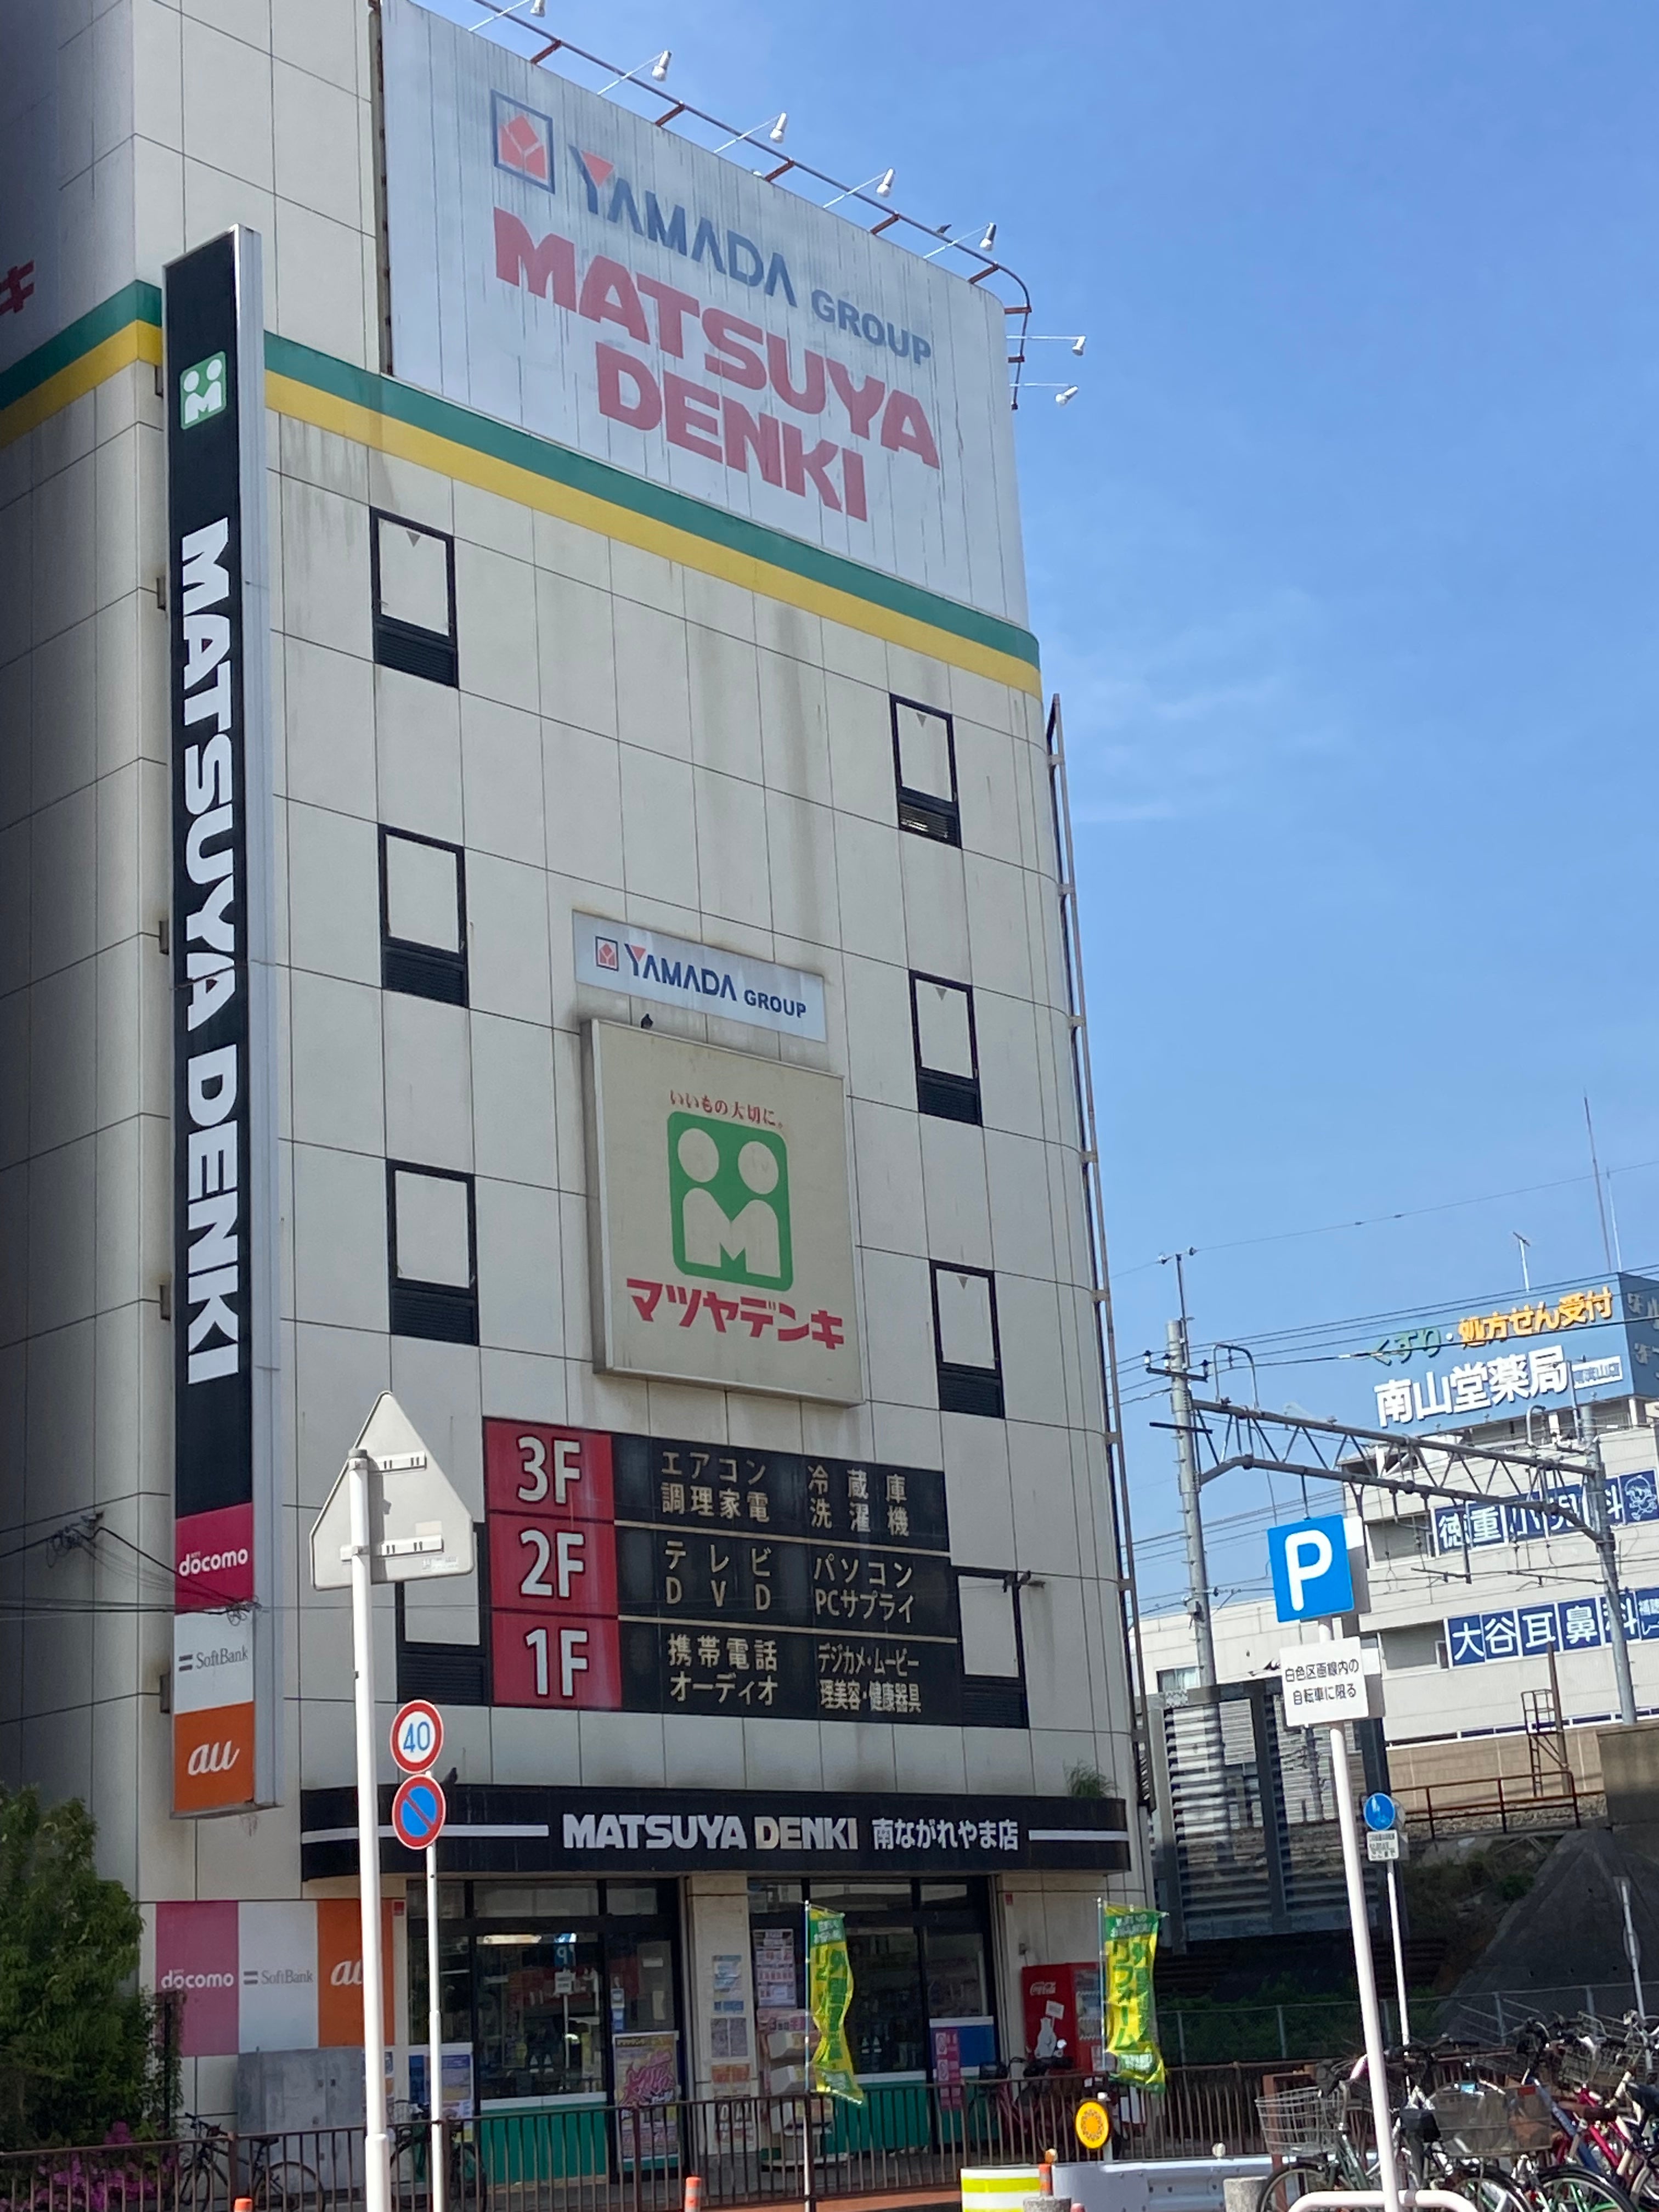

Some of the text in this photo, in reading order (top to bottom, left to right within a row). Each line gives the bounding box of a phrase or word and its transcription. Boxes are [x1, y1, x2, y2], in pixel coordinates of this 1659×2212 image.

[568, 144, 932, 364] YAMADA GROUP
[494, 207, 940, 470] MATSUYA
[595, 341, 867, 522] DENKI
[182, 517, 239, 1384] MATSUYA DENKI
[624, 943, 806, 1019] YAMADA GROUP
[627, 1278, 845, 1350] マツヤデンキ
[1374, 1345, 1568, 1428] 南山堂薬局
[517, 1435, 582, 1505] 3F
[661, 1451, 766, 1486] エアコン
[807, 1464, 907, 1504] 冷蔵庫
[661, 1482, 770, 1523] 調理家電
[809, 1497, 910, 1537] 洗濯機
[179, 1548, 248, 1577] docomo
[519, 1528, 585, 1598] 2F
[664, 1539, 772, 1577] テレビ
[813, 1554, 913, 1588] パソコン
[1284, 1529, 1333, 1612] P
[814, 1588, 915, 1624] PCサプライ
[196, 1645, 249, 1669] SoftBank
[525, 1628, 588, 1698] 1F
[668, 1632, 778, 1672] 携帯電話
[669, 1671, 778, 1707] オーディオ
[402, 1721, 430, 1753] 40
[188, 1740, 240, 1775] au
[563, 1814, 1019, 1850] MATSUYA DENKI 南ながれやま店
[161, 1969, 234, 1989] docomo
[261, 1970, 314, 1985] SoftBank
